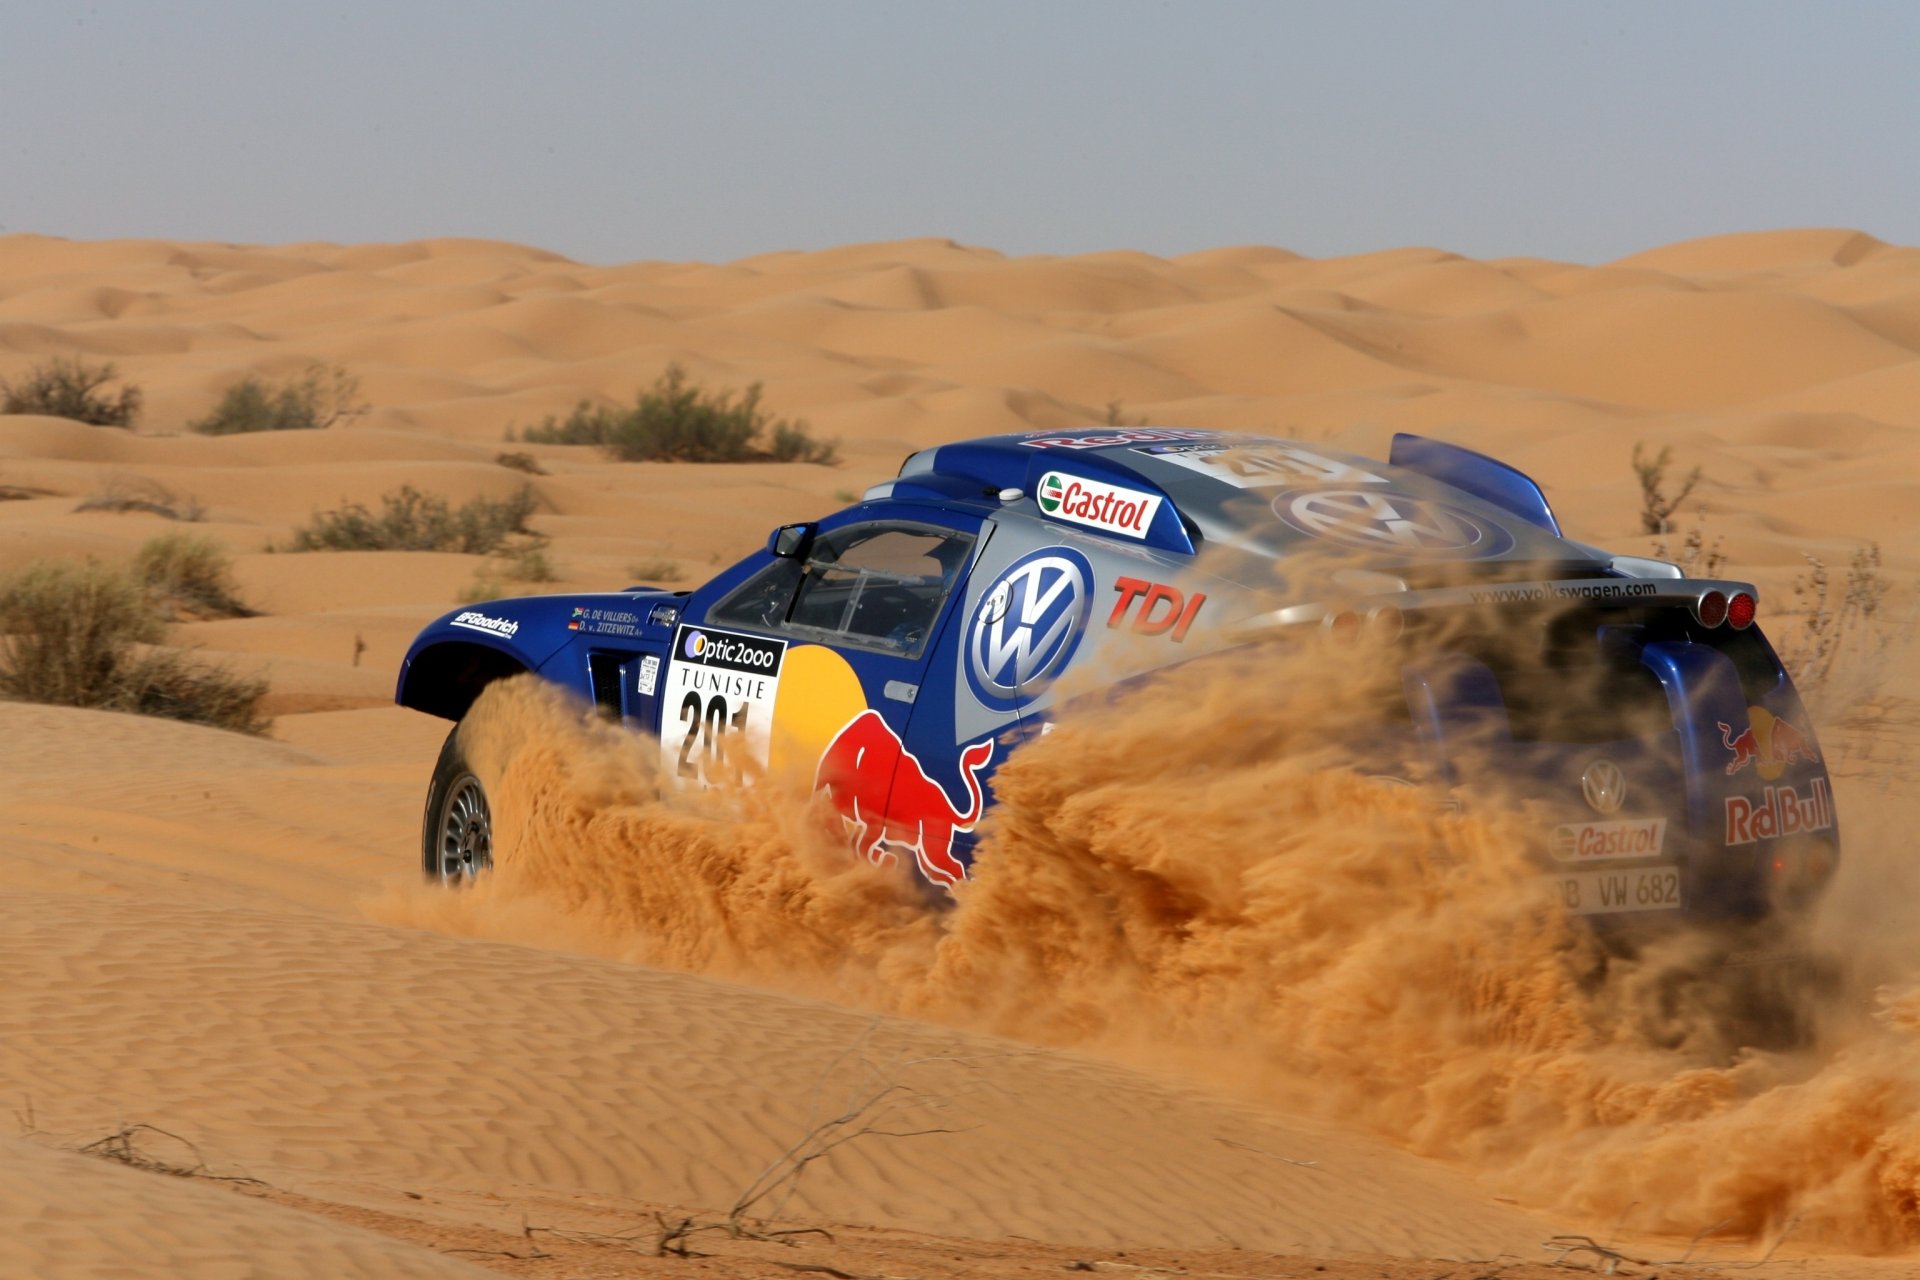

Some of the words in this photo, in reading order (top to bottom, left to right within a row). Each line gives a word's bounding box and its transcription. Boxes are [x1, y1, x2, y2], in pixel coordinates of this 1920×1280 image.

[1062, 482, 1149, 531] Castrol
[1470, 582, 1656, 603] www.volkswagen.com
[454, 611, 519, 635] BFGoodrich
[583, 609, 591, 619] G.
[591, 609, 603, 620] DE
[603, 611, 632, 623] VILLIERS
[1107, 576, 1207, 643] TDI
[579, 621, 587, 631] D.
[596, 622, 635, 635] ZITZEWITZ
[694, 634, 774, 668] Optic2000
[682, 668, 765, 699] TUNISIE
[677, 691, 749, 786] 201
[1576, 823, 1658, 856] Castrol
[1560, 879, 1581, 909] B
[1598, 876, 1628, 906] VW
[1636, 874, 1678, 904] 682
